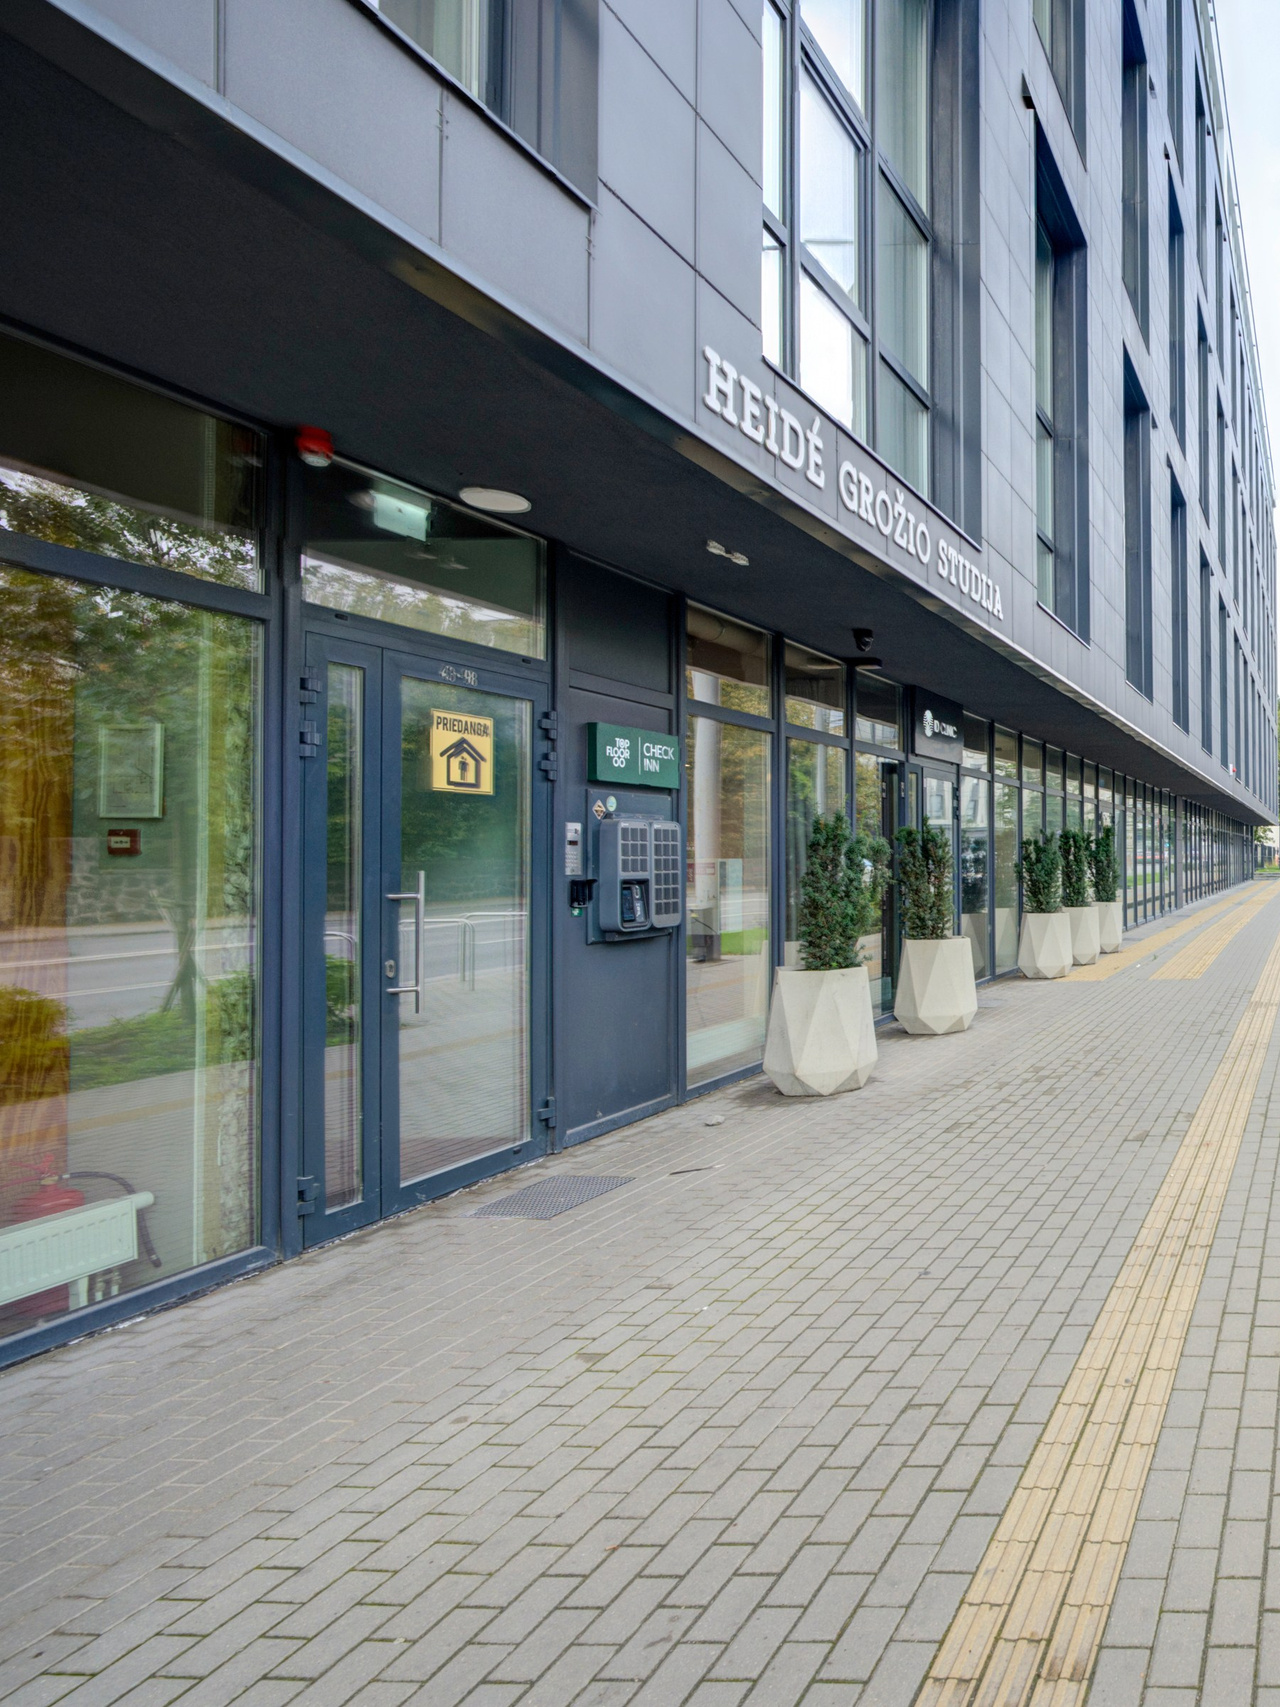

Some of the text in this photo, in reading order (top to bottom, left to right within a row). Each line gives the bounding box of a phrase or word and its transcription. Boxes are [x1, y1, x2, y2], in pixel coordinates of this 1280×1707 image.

[838, 460, 931, 565] GROŽIO
[937, 538, 1005, 621] STUDIJA
[436, 715, 490, 738] PRIEDANGA
[614, 737, 631, 749] TOP
[605, 746, 631, 759] FLOOR
[643, 743, 675, 760] CHECK
[643, 758, 660, 773] INN
